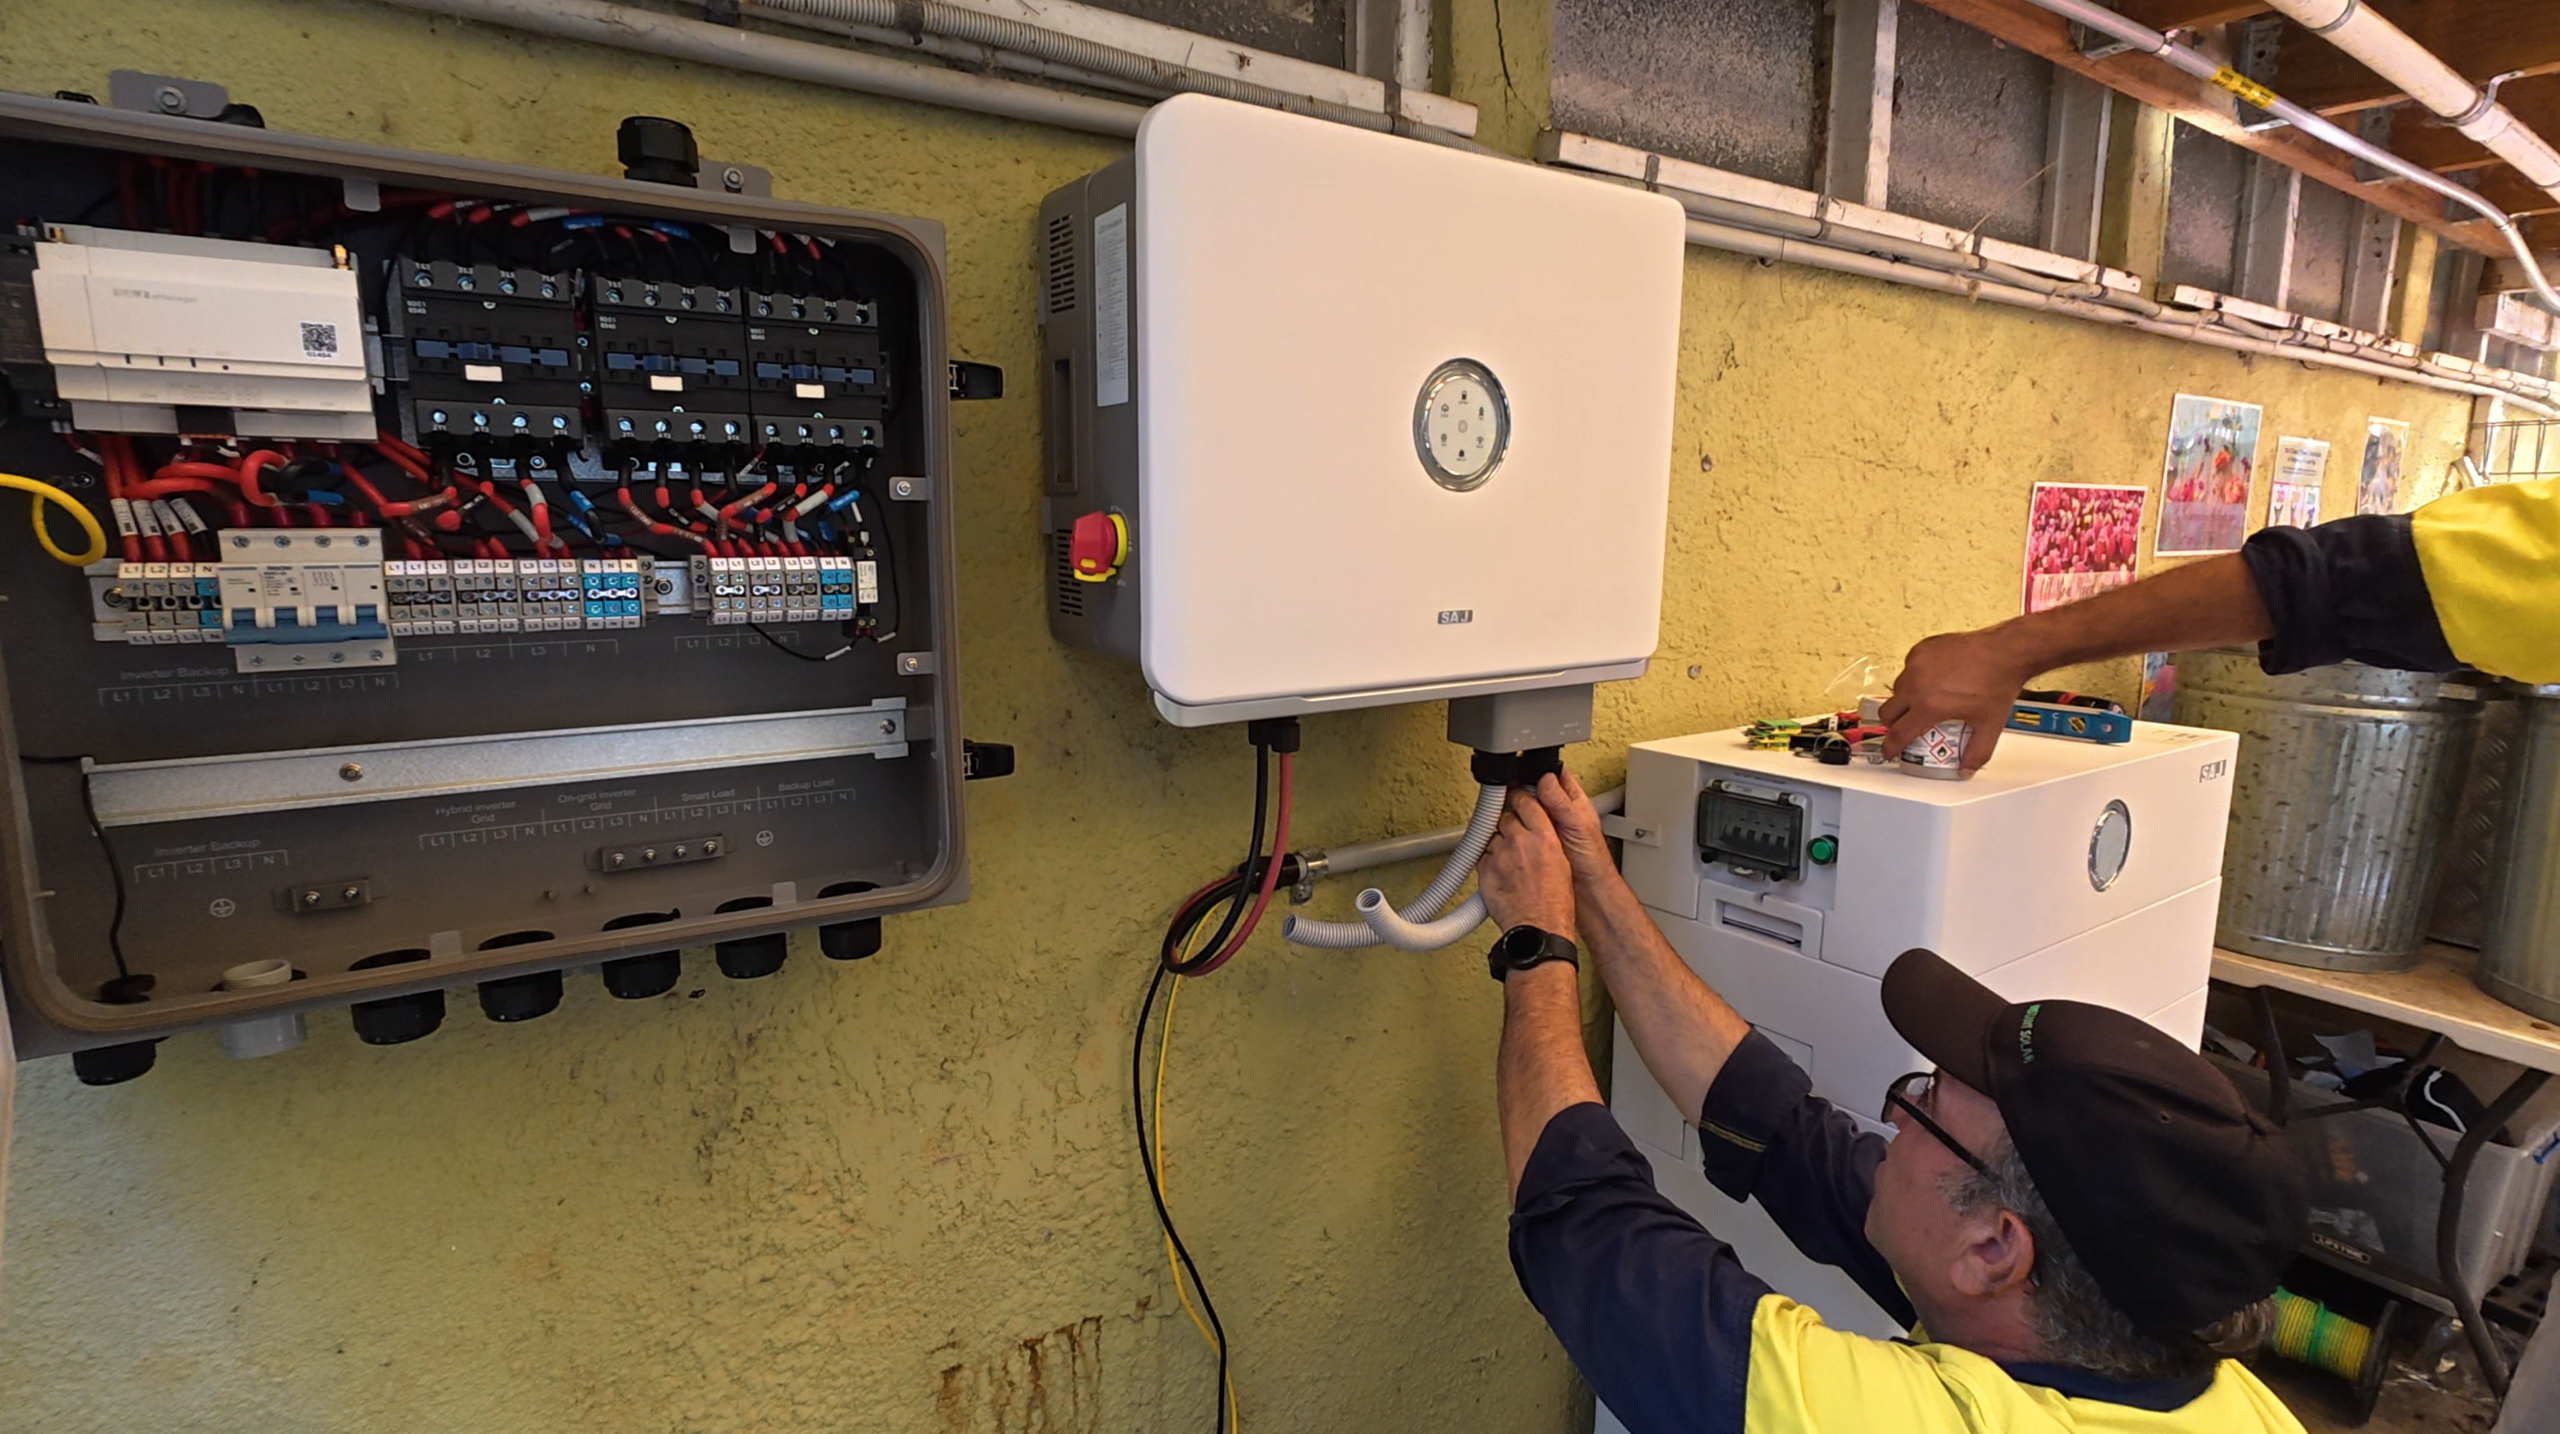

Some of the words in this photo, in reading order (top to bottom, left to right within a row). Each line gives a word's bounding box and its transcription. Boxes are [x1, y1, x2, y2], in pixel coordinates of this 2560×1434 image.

[124, 567, 139, 576] L1
[150, 566, 166, 575] L2
[175, 566, 191, 574] L3
[432, 563, 443, 571] L1
[562, 561, 573, 569] L3
[1440, 610, 1470, 624] SAJ
[132, 635, 149, 643] L1
[686, 639, 699, 649] L1
[718, 637, 732, 647] L2
[748, 635, 761, 646] L3
[779, 633, 788, 644] N
[418, 651, 433, 661] L1
[475, 648, 491, 658] L2
[530, 645, 546, 656] L3
[585, 643, 597, 653] N
[177, 666, 229, 678] Backup
[266, 682, 284, 693] L1
[303, 680, 320, 691] L2
[338, 678, 355, 689] L3
[374, 676, 386, 686] N
[112, 691, 131, 702] L1
[152, 688, 171, 700] L2
[191, 686, 211, 697] L3
[232, 684, 244, 694] N
[2200, 759, 2227, 783] SAJ
[589, 801, 612, 811] Grid
[766, 800, 778, 809] L1
[790, 796, 803, 806] L2
[434, 803, 472, 817] Hybrid
[664, 810, 676, 820] L1
[690, 808, 704, 817] L2
[716, 804, 729, 814] L3
[742, 802, 751, 811] N
[470, 812, 496, 824] Grid
[552, 822, 566, 833] L1
[581, 819, 596, 829] L2
[609, 816, 624, 826] L3
[638, 813, 648, 823] N
[430, 836, 445, 847] L1
[461, 832, 478, 843] L2
[492, 829, 508, 840] L3
[524, 826, 535, 836] N
[148, 866, 165, 878] L1
[185, 862, 204, 874] L2
[224, 858, 242, 870] L3
[262, 854, 275, 865] N
